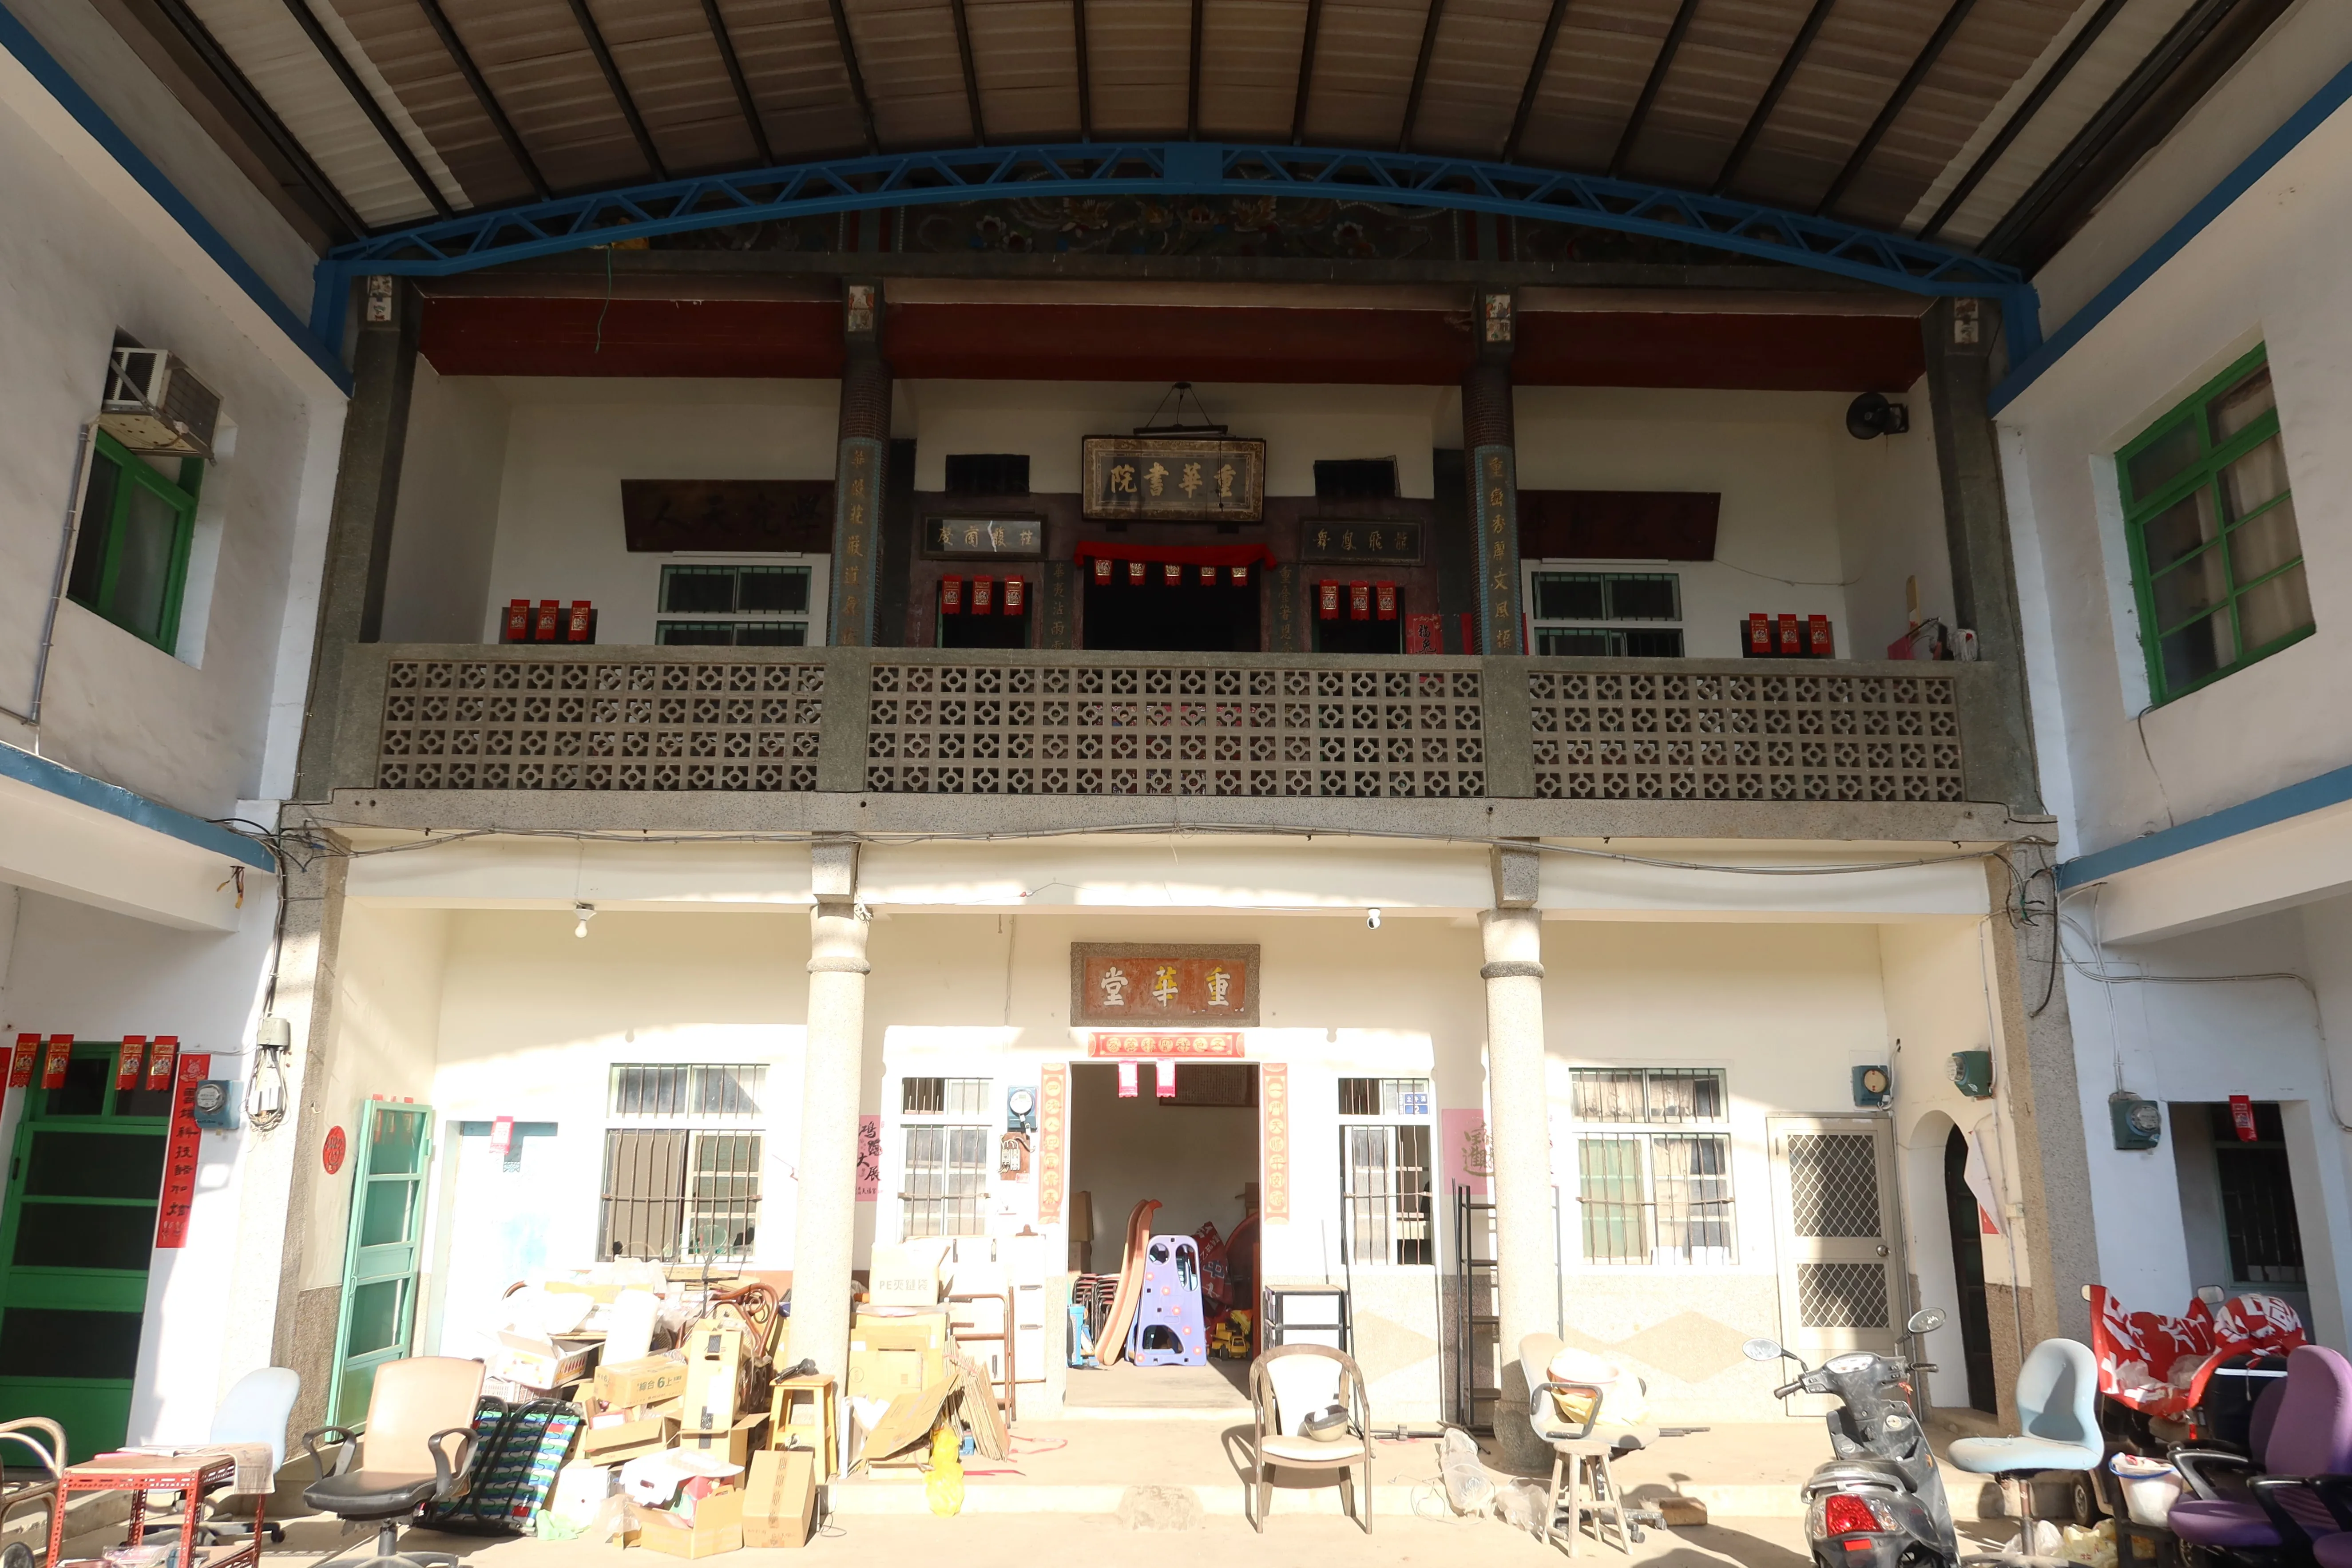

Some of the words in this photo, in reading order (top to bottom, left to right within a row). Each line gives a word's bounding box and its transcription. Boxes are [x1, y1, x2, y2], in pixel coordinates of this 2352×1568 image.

[1110, 461, 1237, 499] 重華書院
[1312, 527, 1409, 552] 龍飛鳳舞
[1101, 965, 1231, 1007] 重華堂
[1414, 1105, 1420, 1114] 2
